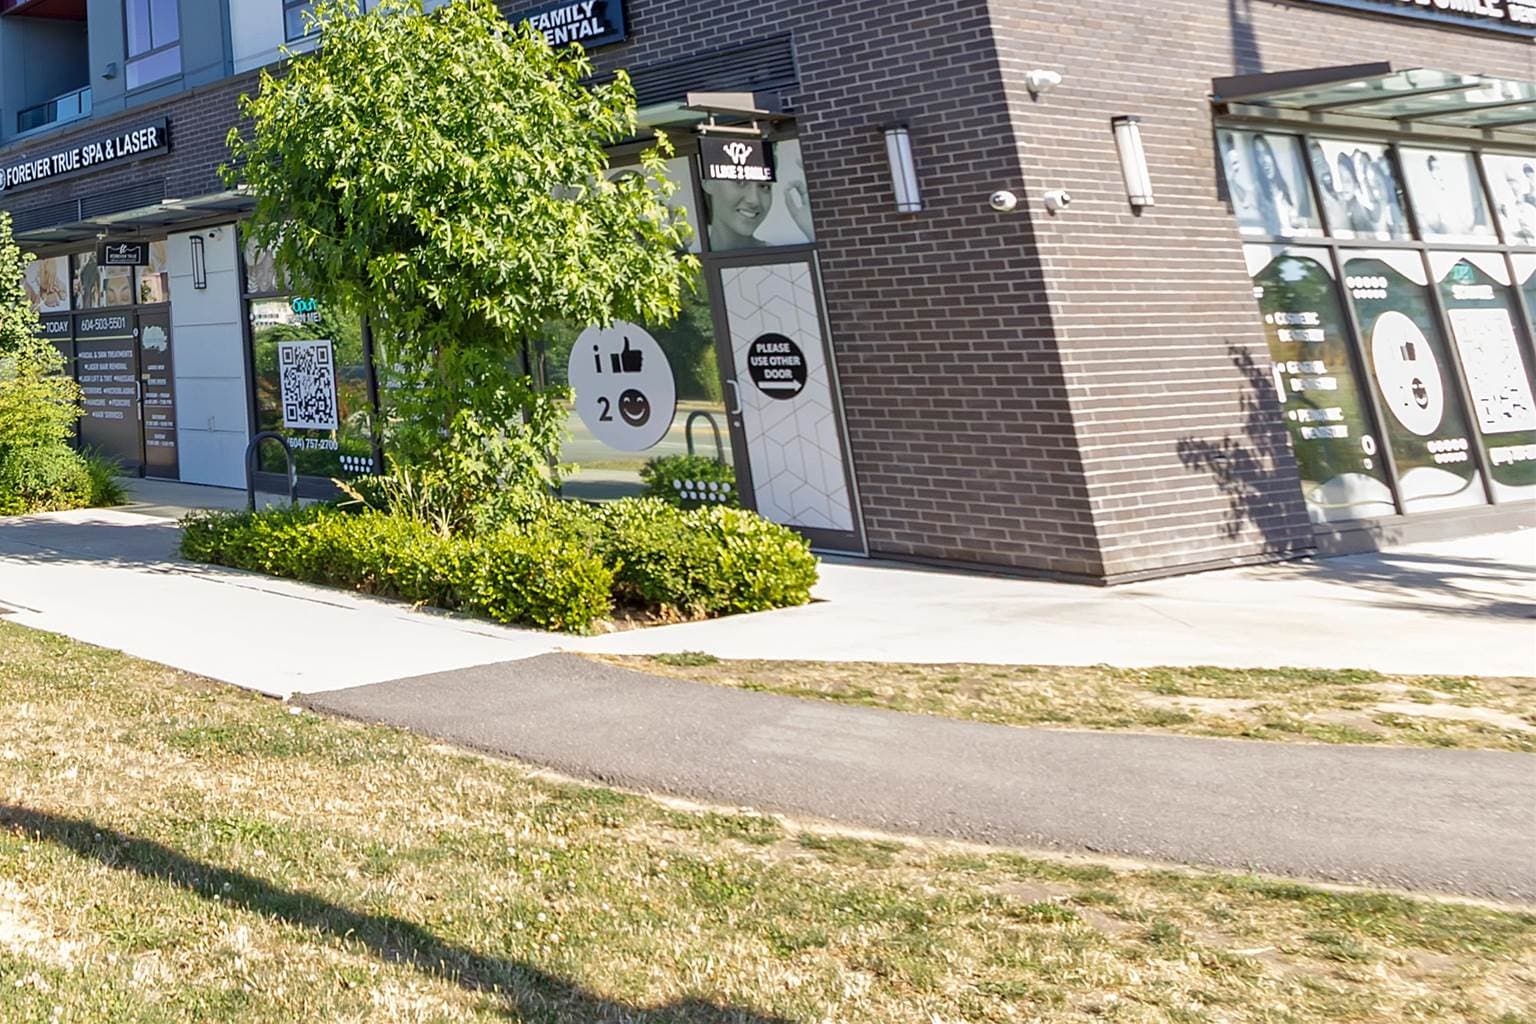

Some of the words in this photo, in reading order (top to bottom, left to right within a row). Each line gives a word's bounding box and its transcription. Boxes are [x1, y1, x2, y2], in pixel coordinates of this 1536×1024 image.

[529, 0, 596, 32] FAMILY
[543, 17, 604, 47] ENTAL
[6, 157, 51, 187] FOREVER
[52, 149, 80, 175] TRUE
[81, 143, 104, 167] SPA
[105, 139, 114, 160] &
[116, 126, 158, 157] LASER
[46, 321, 68, 333] TODAY
[756, 343, 791, 353] PLEASE
[750, 356, 769, 366] USE
[769, 356, 801, 366] OTHER
[763, 368, 793, 379] DOOR
[597, 396, 613, 422] 2
